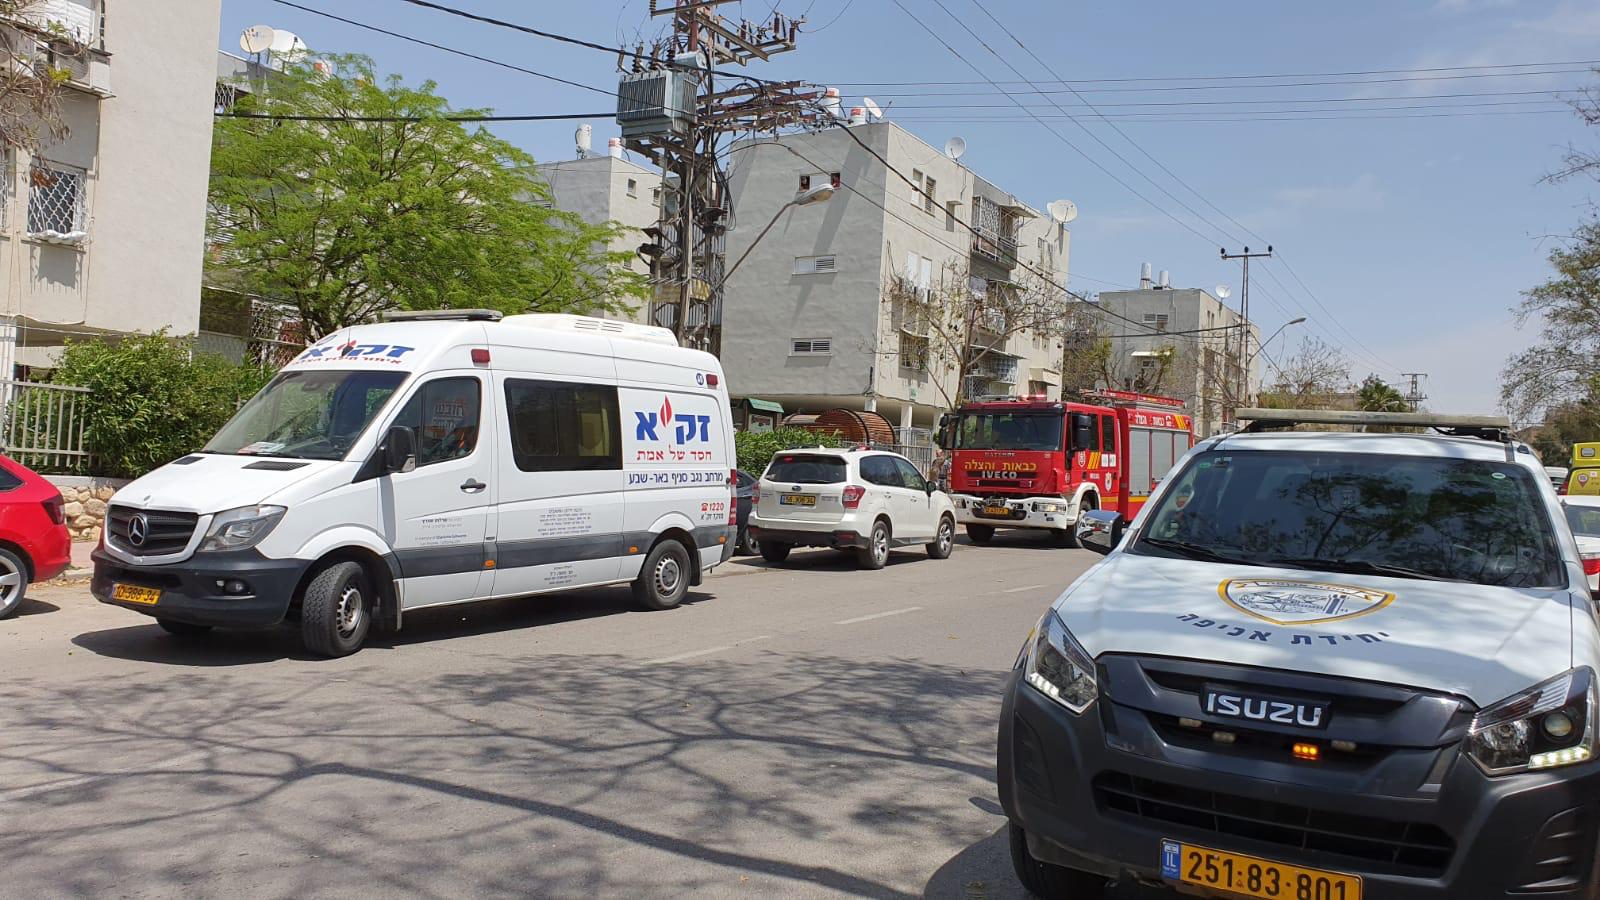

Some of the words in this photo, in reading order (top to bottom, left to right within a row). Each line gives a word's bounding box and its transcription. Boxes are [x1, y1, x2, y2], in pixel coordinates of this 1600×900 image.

[637, 450, 664, 461] אמת
[668, 444, 685, 461] של
[690, 451, 712, 461] חסד
[964, 459, 995, 470] והצלה
[1003, 462, 1037, 471] כבאות
[671, 472, 688, 485] סניף
[690, 472, 702, 482] נגב
[705, 472, 724, 482] מרחב
[982, 471, 1018, 479] IVECO
[709, 502, 725, 511] 1220
[1176, 613, 1272, 642] אכיפה
[1290, 631, 1390, 645] יחידת
[1207, 693, 1322, 727] ISUZU
